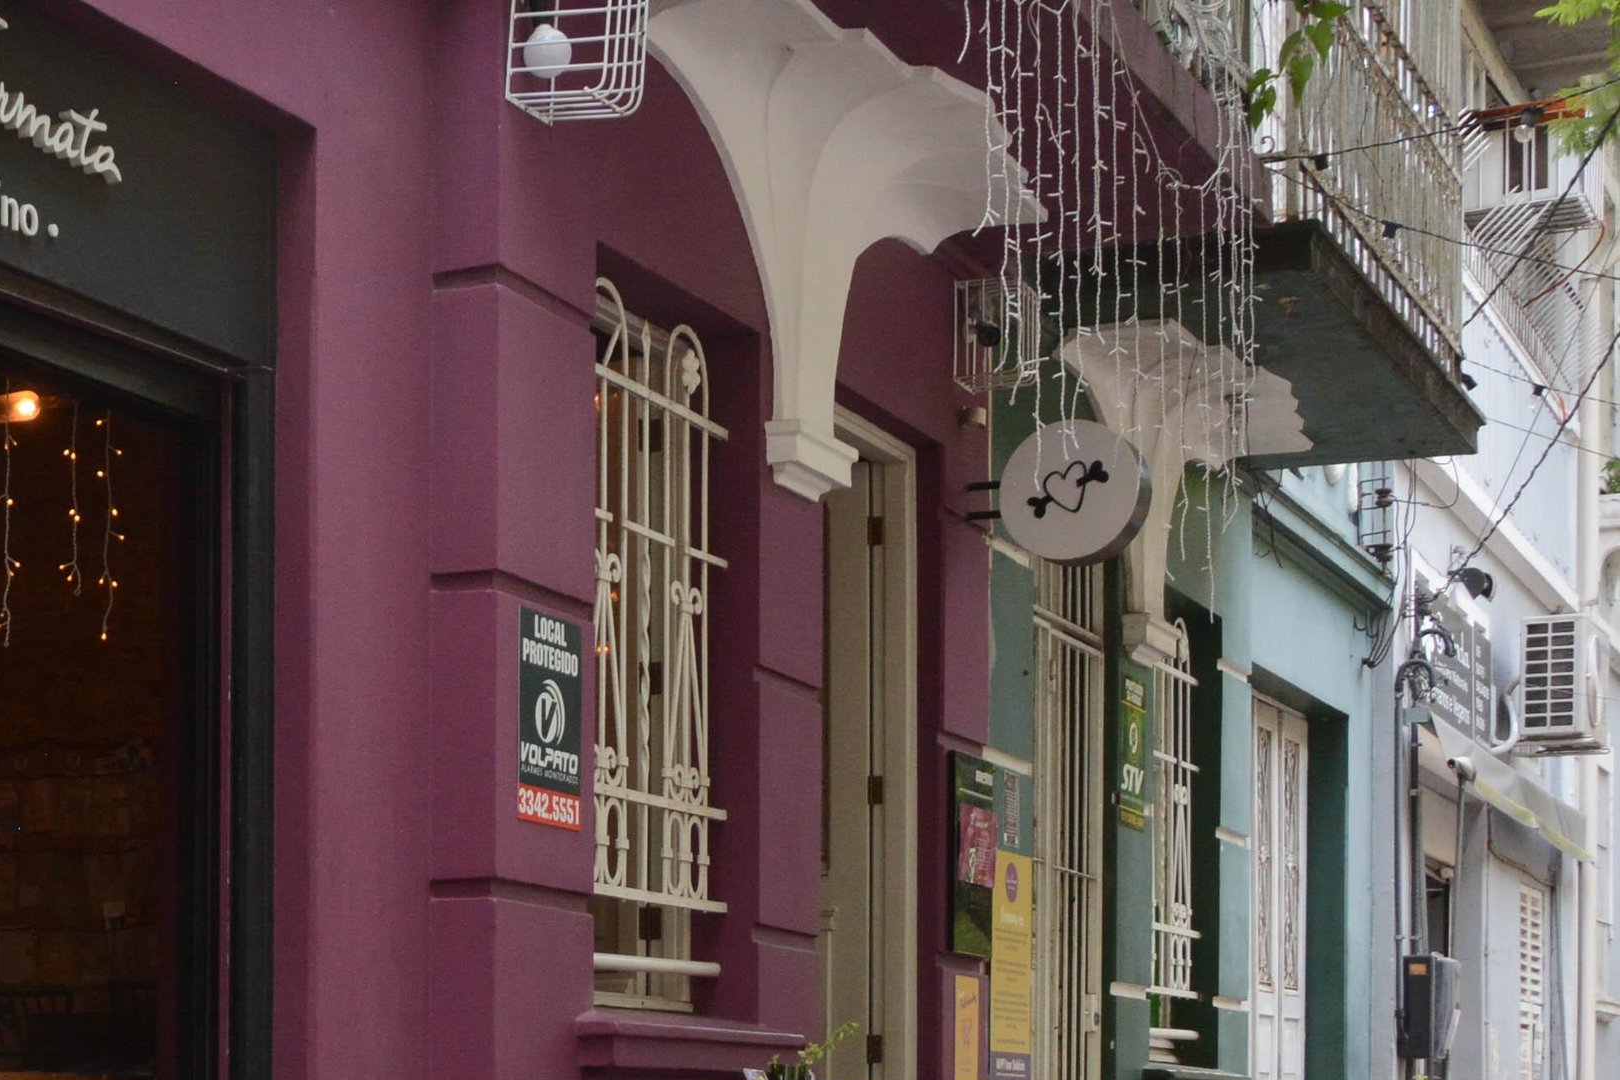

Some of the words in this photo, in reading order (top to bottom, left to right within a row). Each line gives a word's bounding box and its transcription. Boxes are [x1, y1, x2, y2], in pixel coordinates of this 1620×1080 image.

[533, 613, 568, 647] LOCAL
[521, 637, 580, 678] PROTEGIDO
[520, 740, 580, 775] VOLPATO
[1120, 763, 1145, 795] STV
[518, 787, 580, 826] 3342.5551
